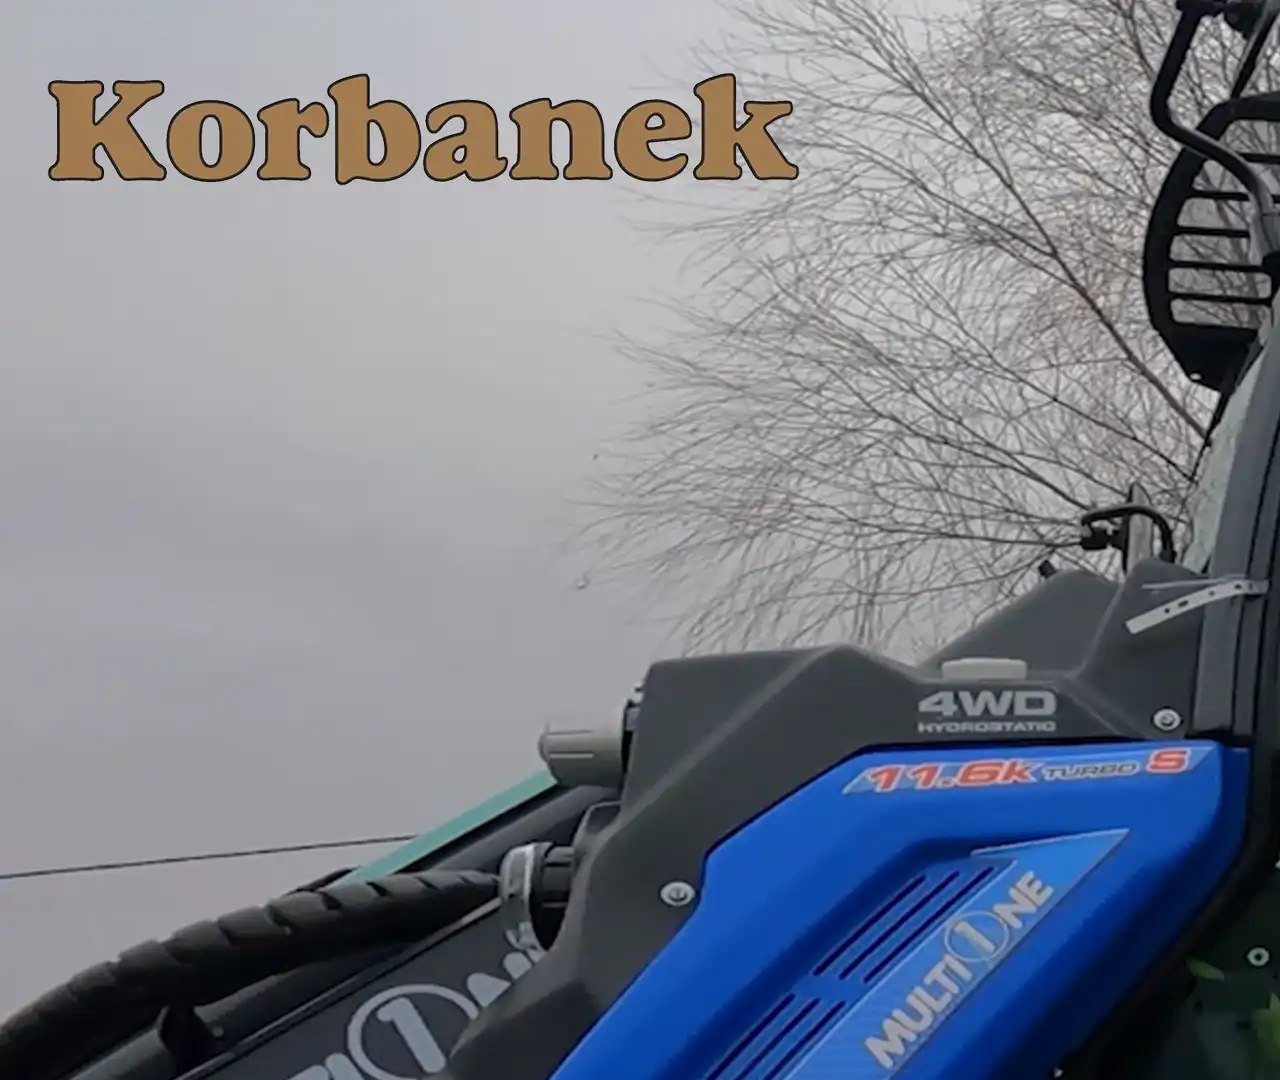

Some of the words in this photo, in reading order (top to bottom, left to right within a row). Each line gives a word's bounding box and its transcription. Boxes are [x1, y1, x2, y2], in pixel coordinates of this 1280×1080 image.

[918, 690, 1057, 716] 4WD
[918, 721, 1057, 733] HYDROSTATIC
[1042, 763, 1140, 781] TURBO
